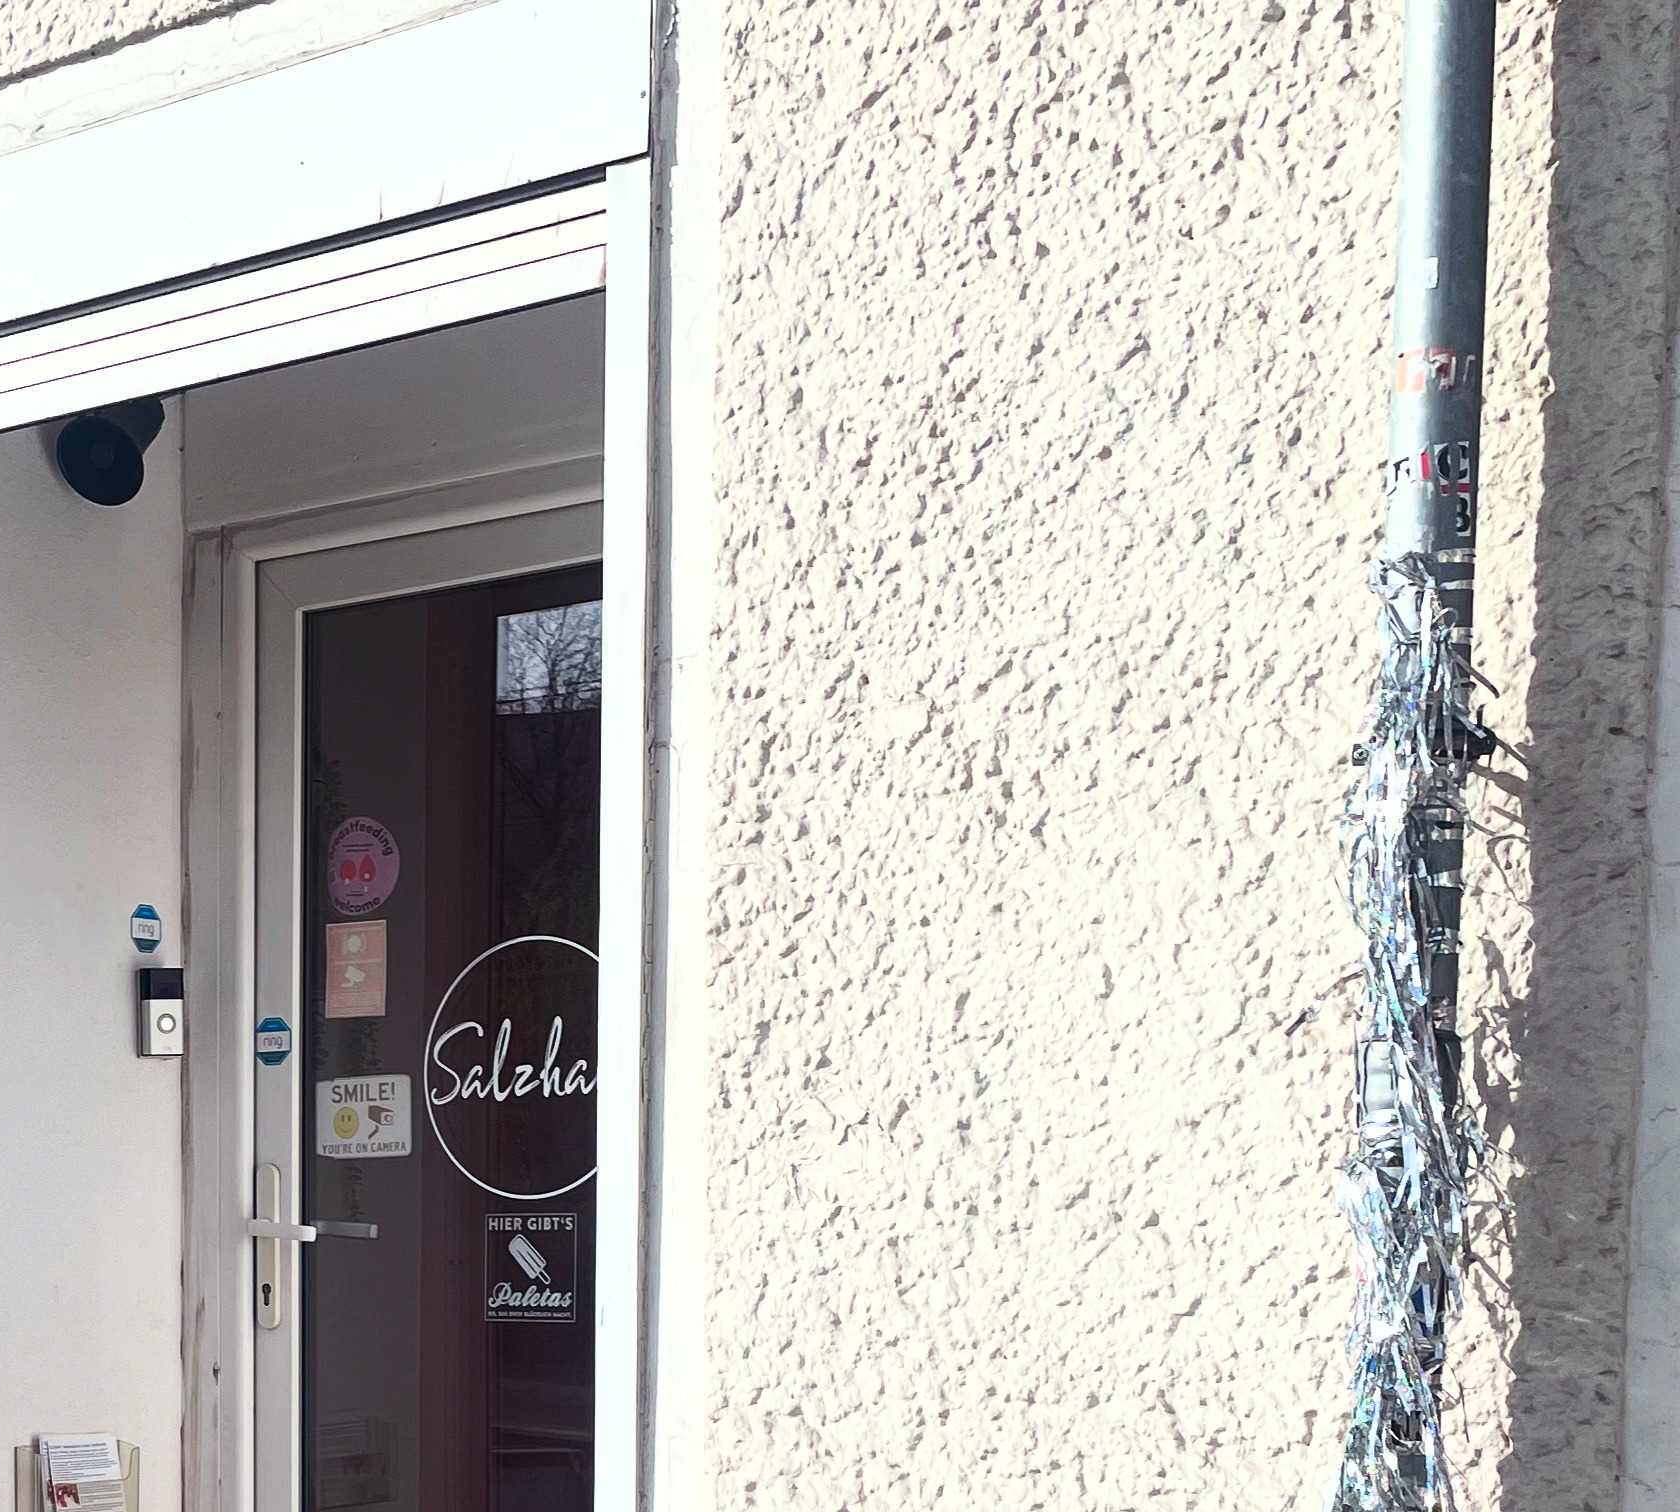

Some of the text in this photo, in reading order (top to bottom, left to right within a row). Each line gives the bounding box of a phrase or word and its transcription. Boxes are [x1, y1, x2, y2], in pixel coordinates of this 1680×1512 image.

[137, 922, 155, 937] ring
[263, 1035, 283, 1049] ring
[431, 1015, 598, 1106] Salzha
[331, 1081, 396, 1104] SMILE!
[321, 1140, 407, 1155] YOU'RE ON CAMERA
[488, 1217, 522, 1231] HIER
[488, 1282, 573, 1308] Paletas
